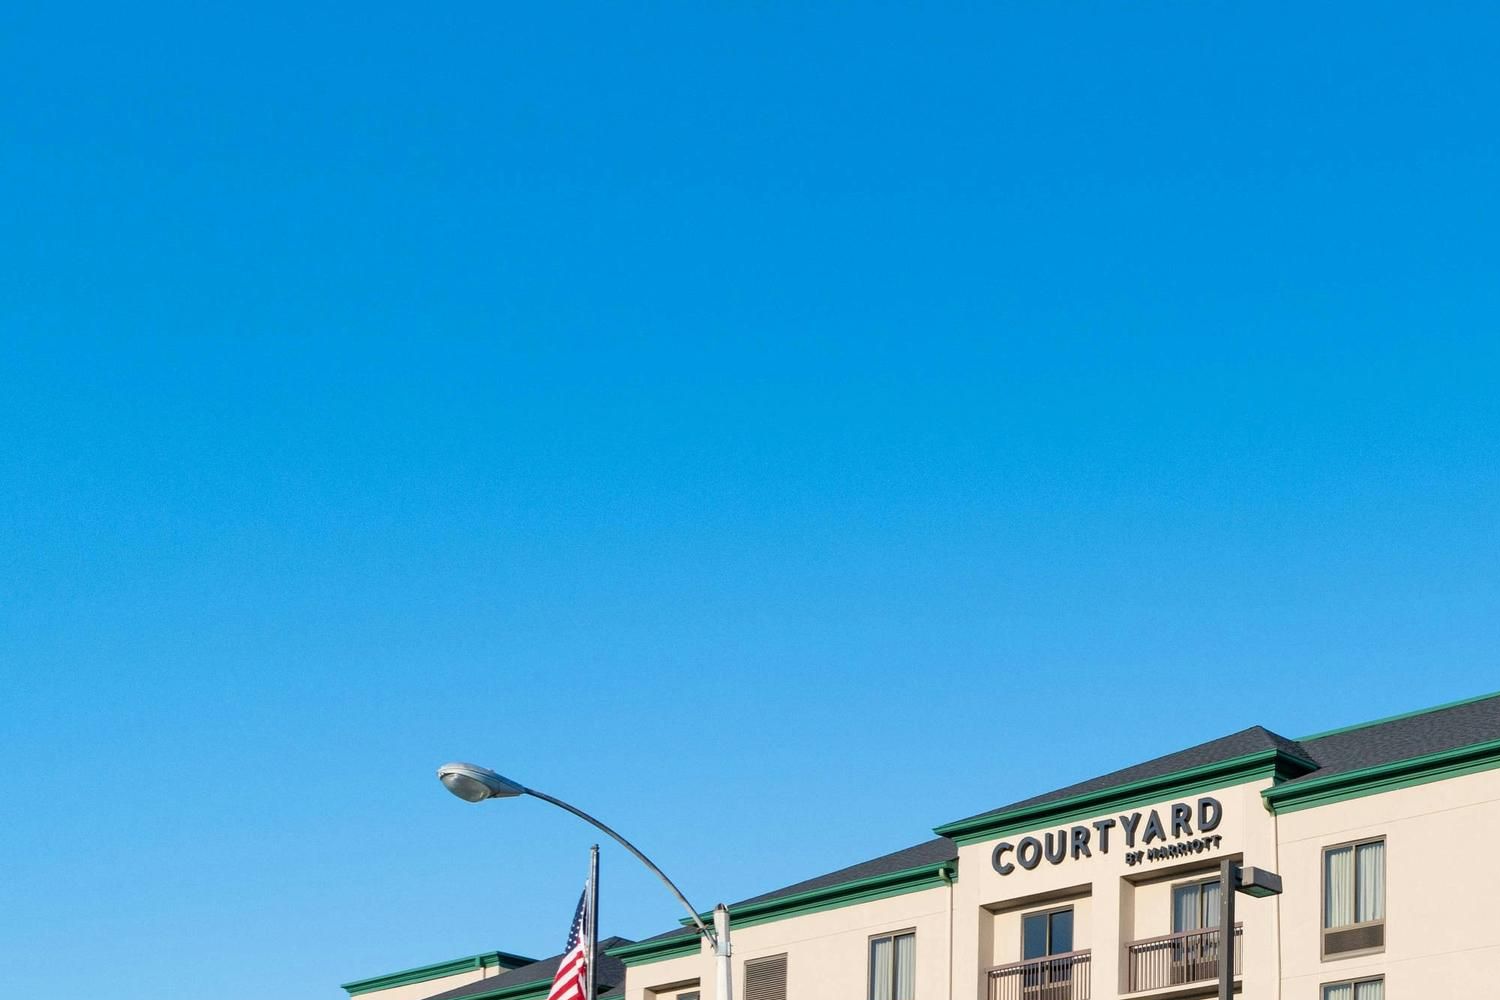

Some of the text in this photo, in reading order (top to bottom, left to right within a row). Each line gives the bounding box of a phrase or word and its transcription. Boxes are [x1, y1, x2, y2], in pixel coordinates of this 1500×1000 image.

[991, 796, 1223, 876] COURTYARD
[1125, 834, 1223, 867] BY MARRIOTT
